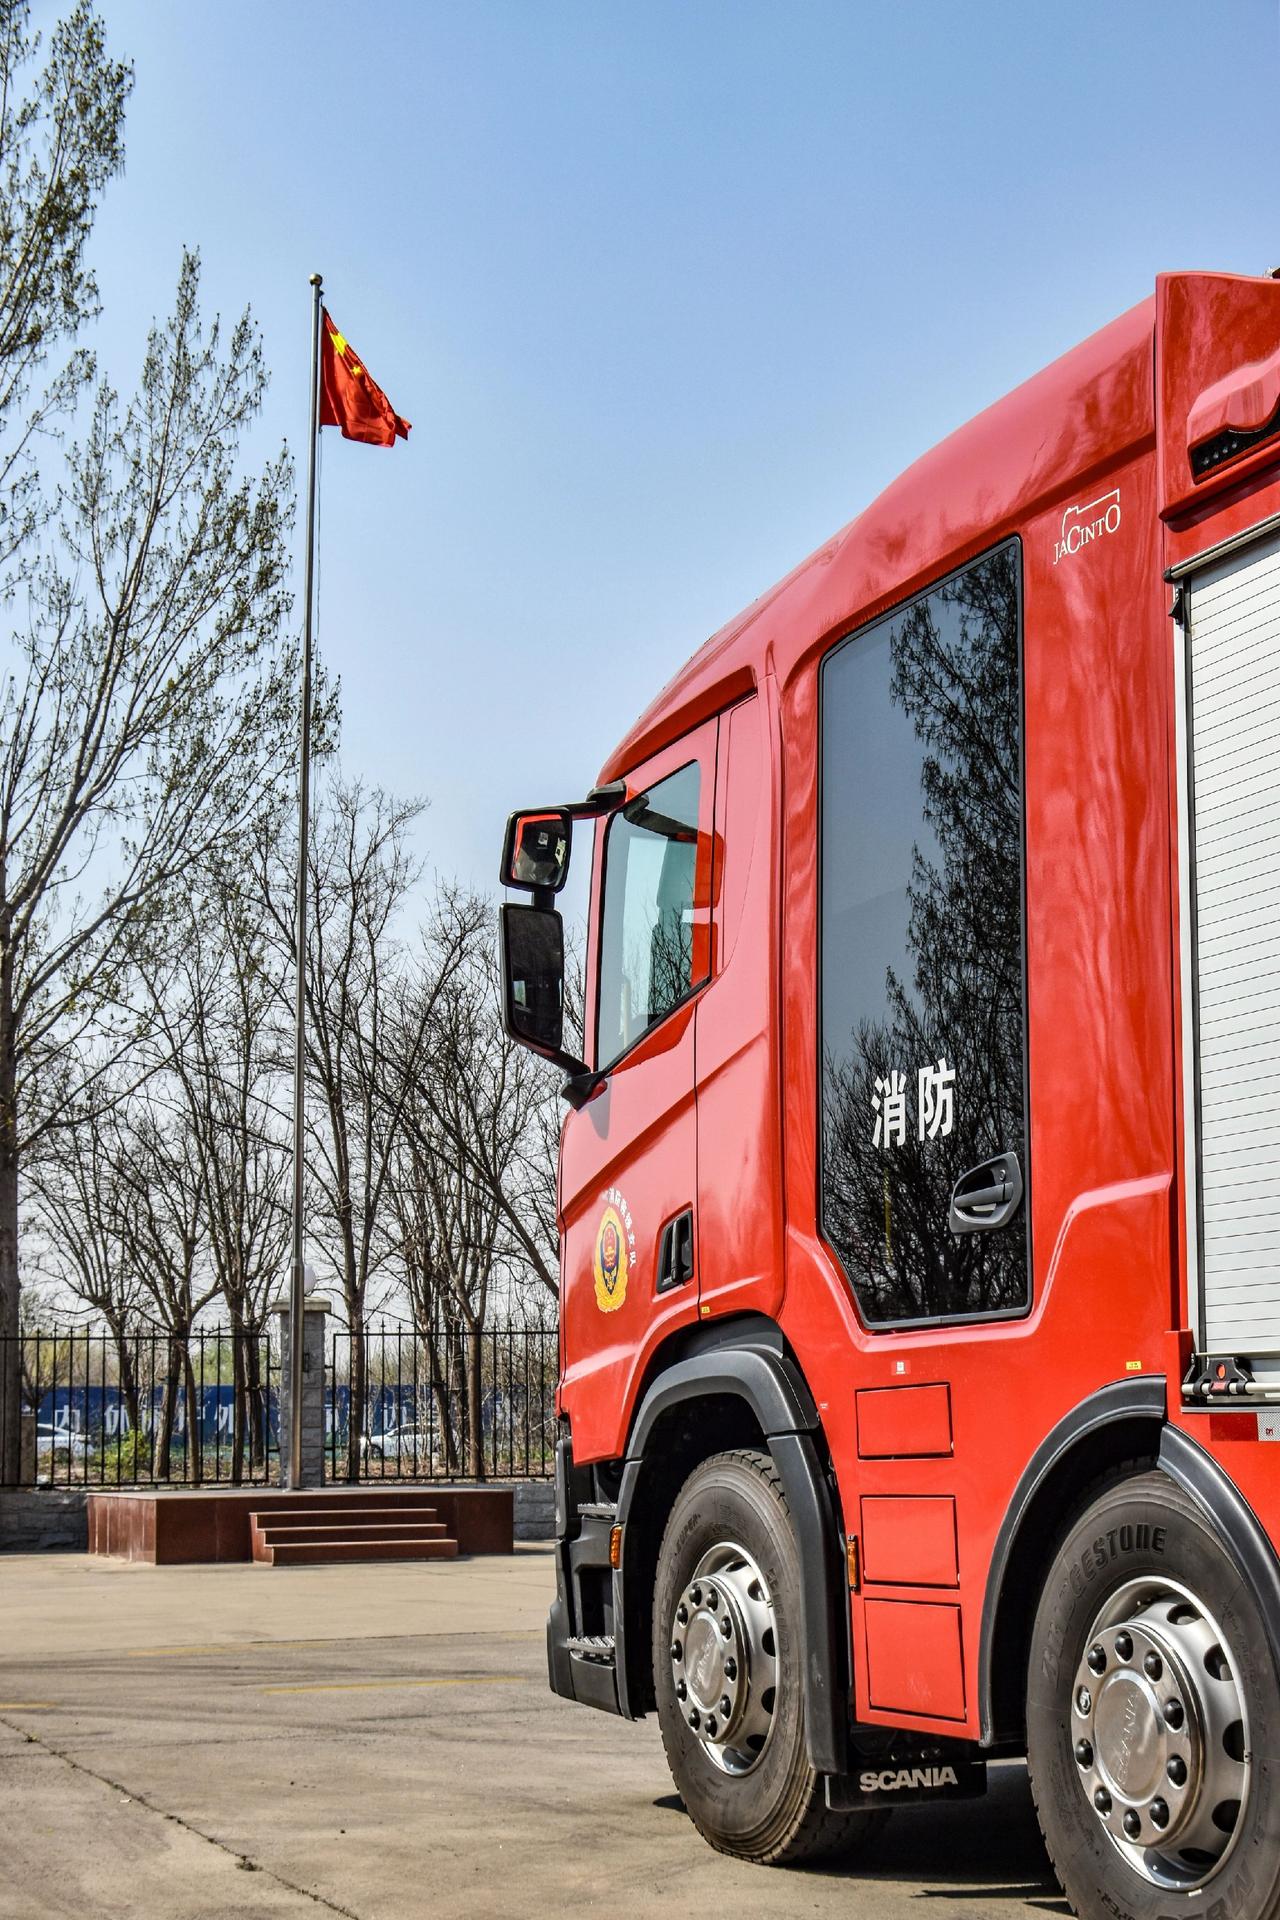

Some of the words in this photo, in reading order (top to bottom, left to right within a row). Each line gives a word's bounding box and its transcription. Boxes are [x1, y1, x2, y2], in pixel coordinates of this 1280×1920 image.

[1053, 504, 1121, 565] JACINTO
[871, 1058, 956, 1150] 消防
[859, 1766, 958, 1793] SCANIA
